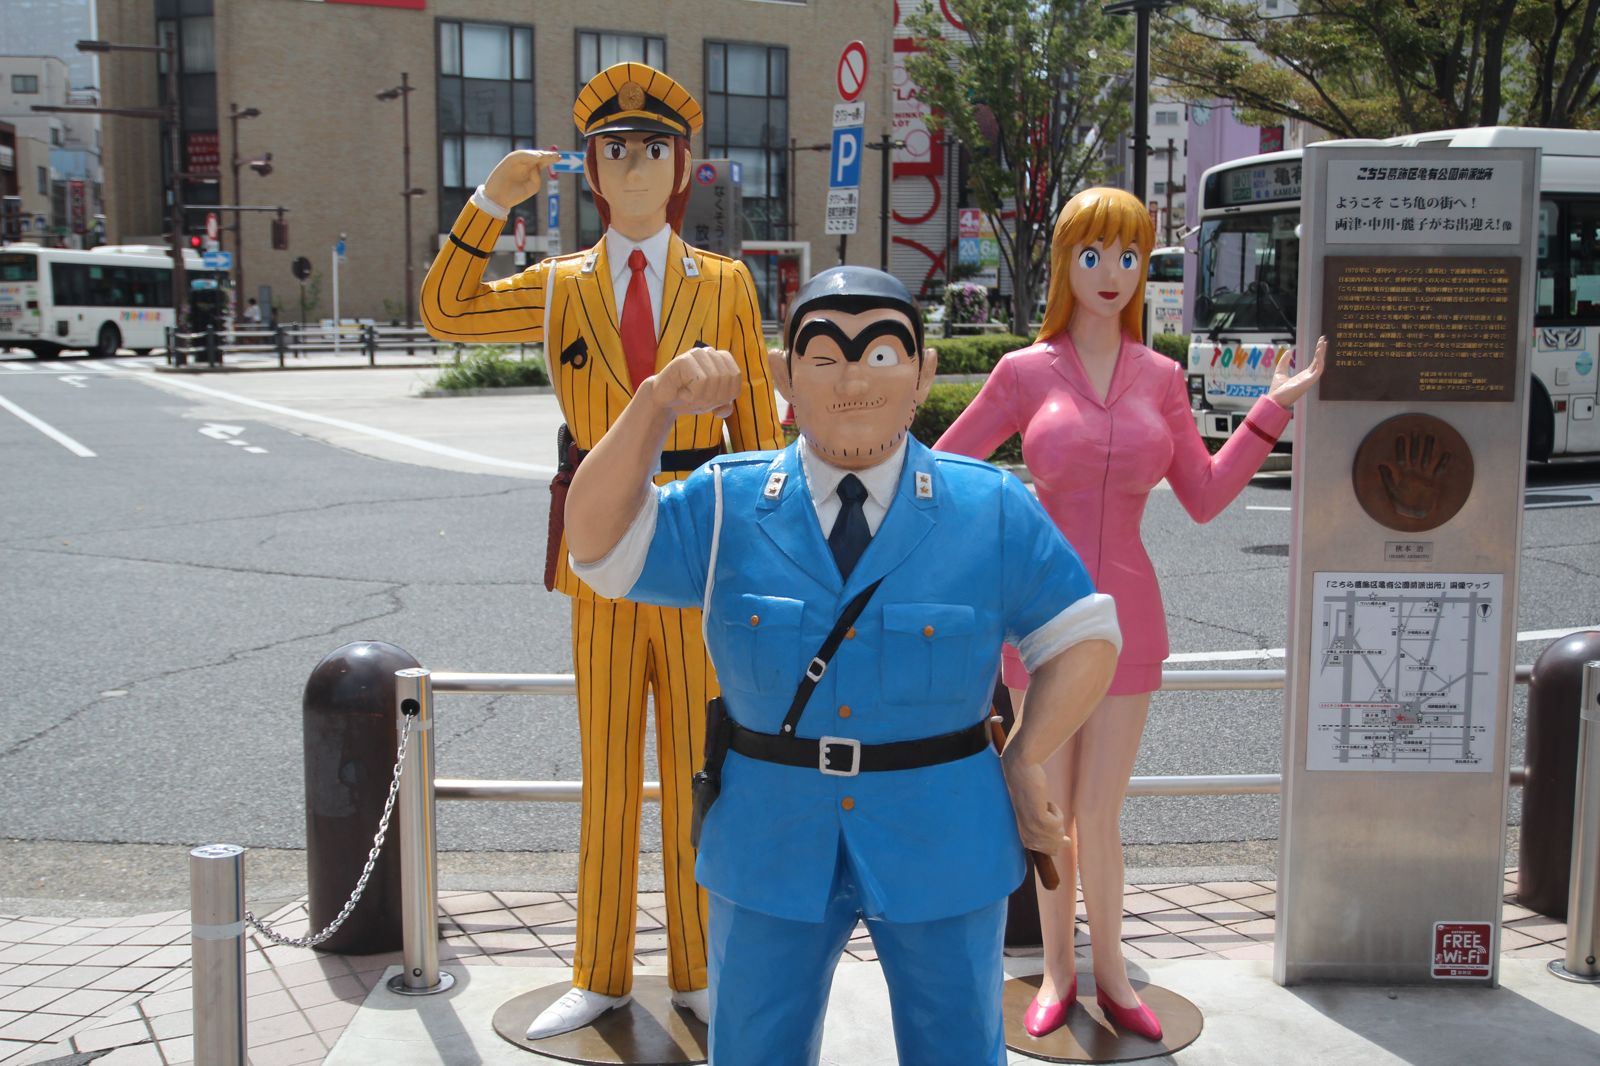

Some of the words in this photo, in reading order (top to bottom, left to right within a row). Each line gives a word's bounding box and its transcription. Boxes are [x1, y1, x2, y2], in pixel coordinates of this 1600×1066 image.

[837, 133, 857, 182] P
[1357, 167, 1494, 181] こちら葛飾区亀有公園前派出所
[1336, 196, 1384, 209] ようこそ
[1443, 934, 1481, 948] FREE
[1443, 950, 1480, 963] Wi-Fi
